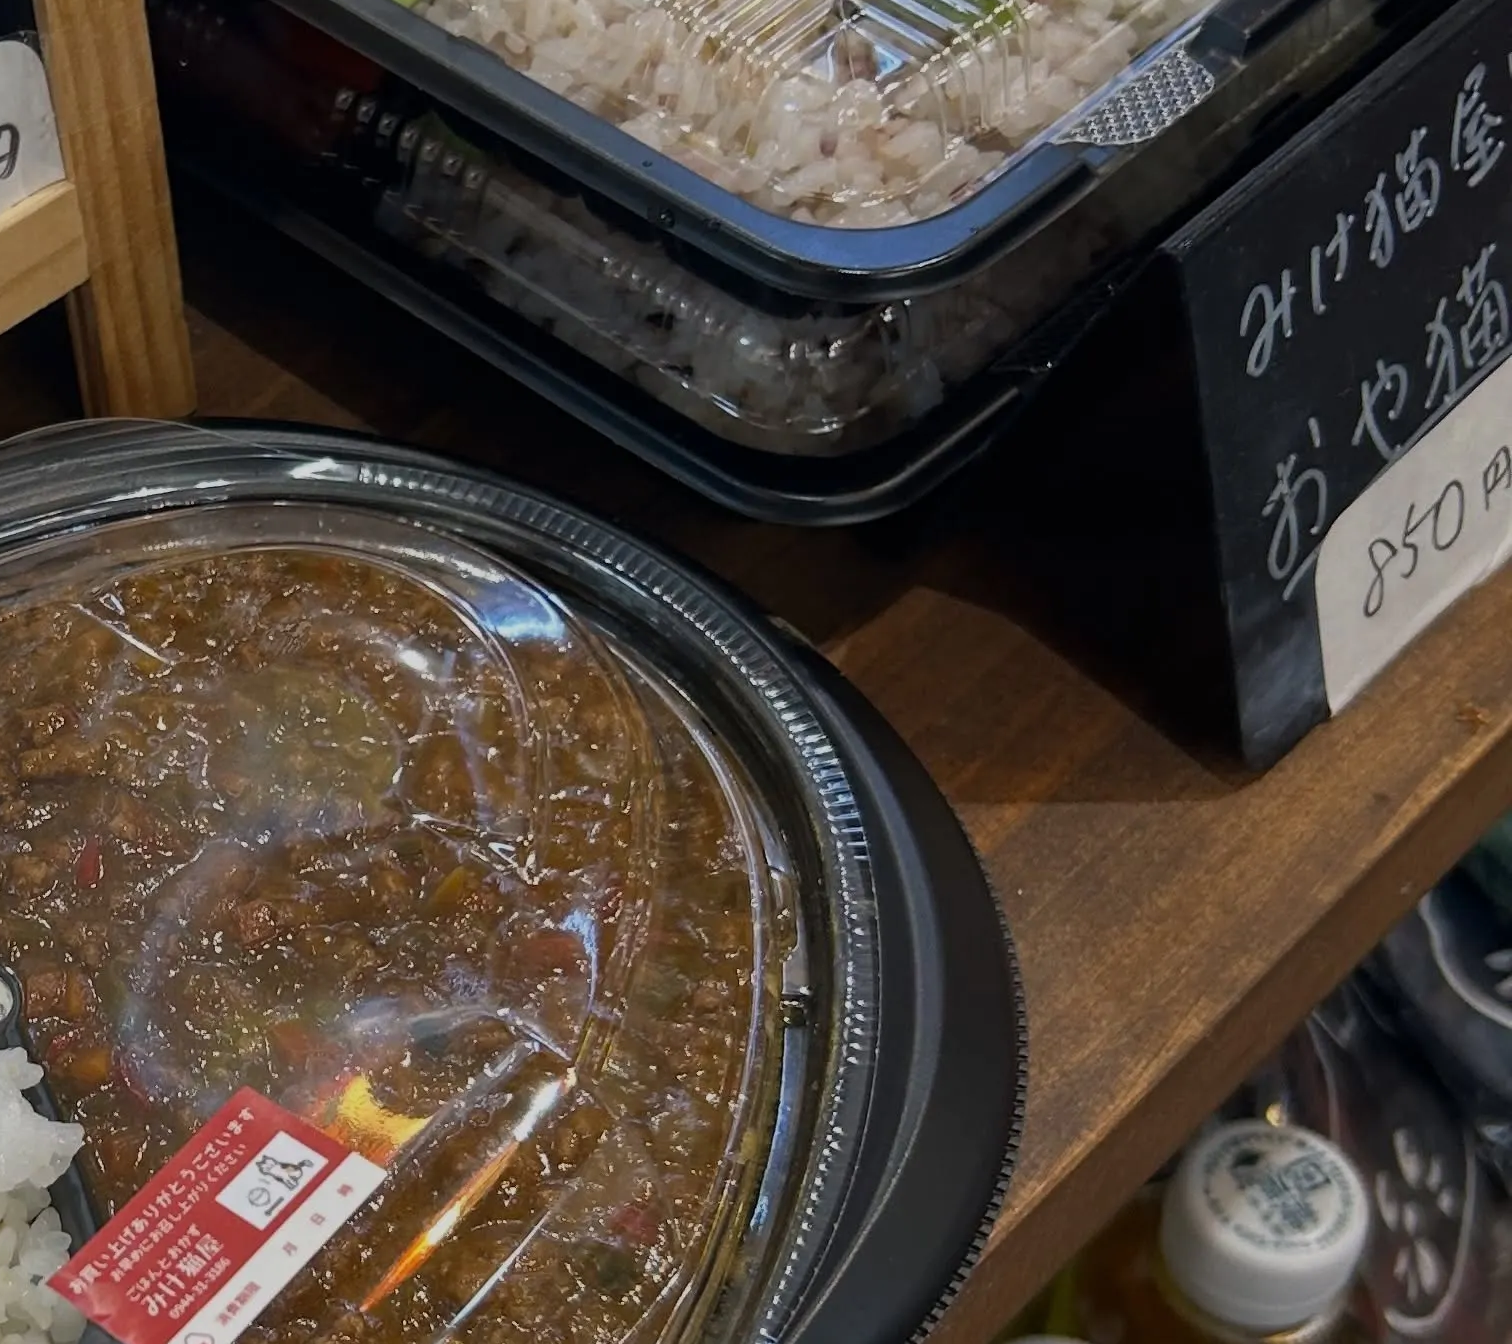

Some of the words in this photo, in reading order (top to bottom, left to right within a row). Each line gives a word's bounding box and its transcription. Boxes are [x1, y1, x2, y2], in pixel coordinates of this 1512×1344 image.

[68, 1107, 255, 1296] お買い上げありがとうございます
[127, 1223, 201, 1303] ごはんとおかず
